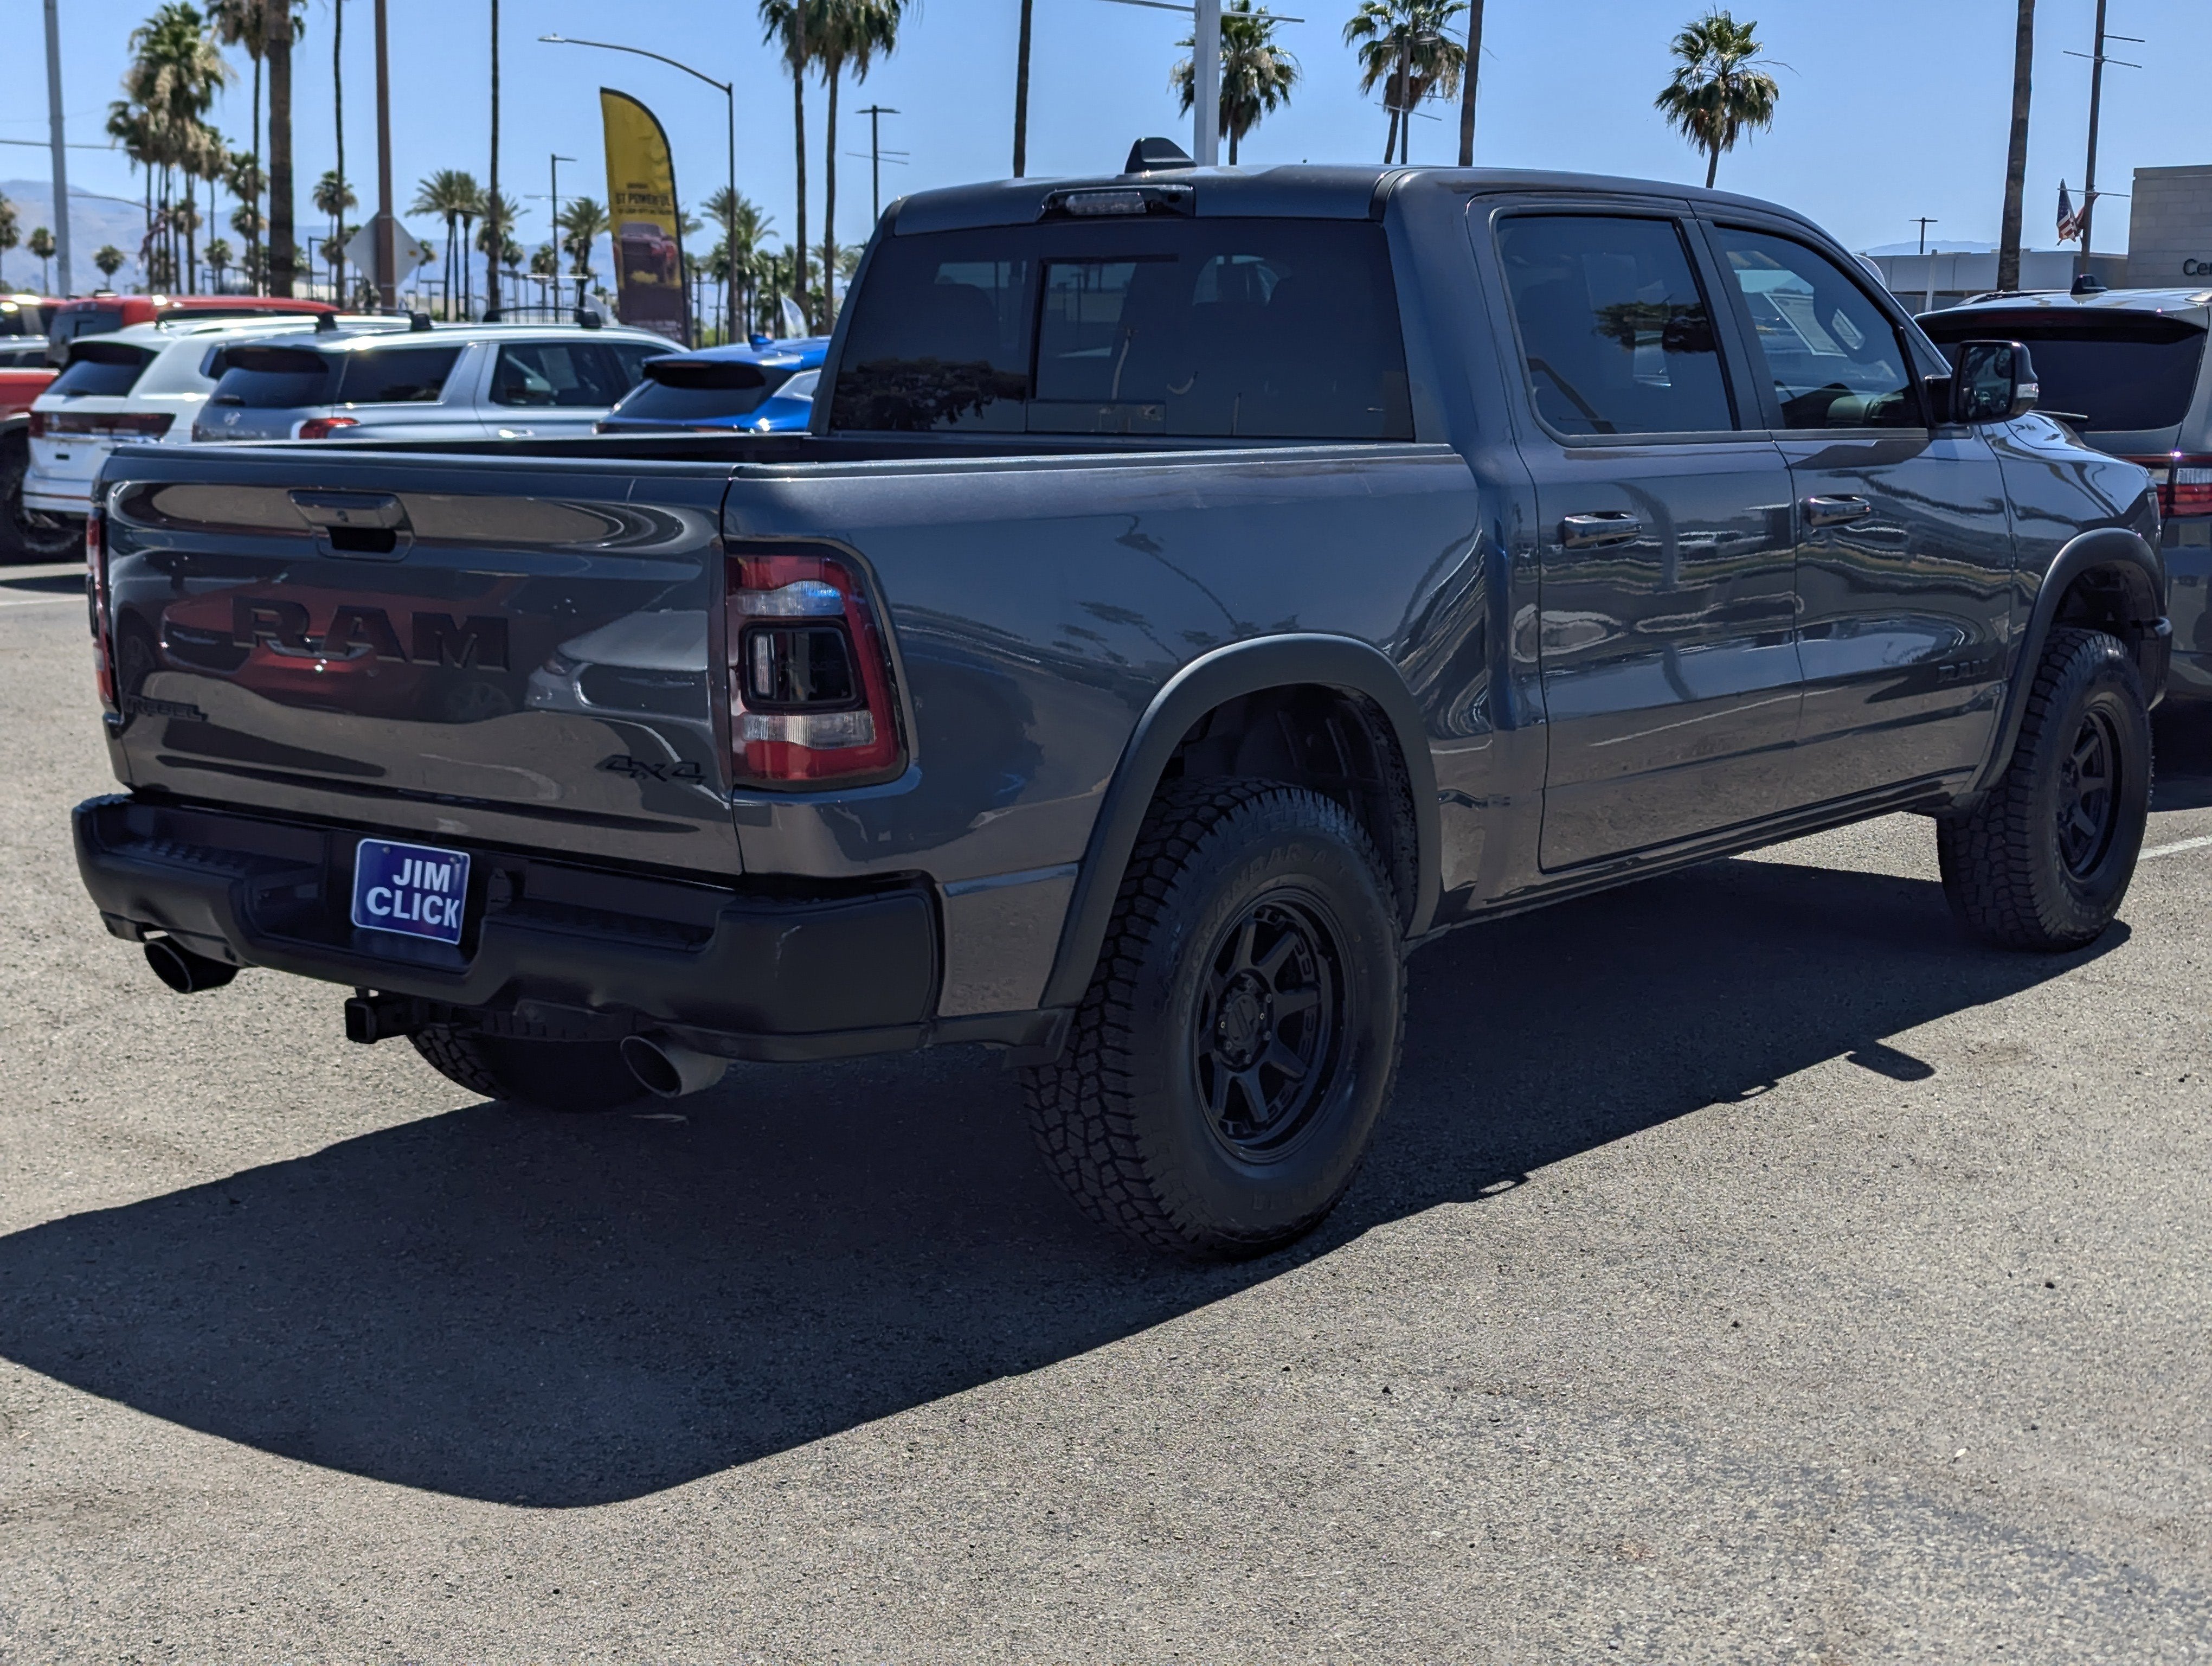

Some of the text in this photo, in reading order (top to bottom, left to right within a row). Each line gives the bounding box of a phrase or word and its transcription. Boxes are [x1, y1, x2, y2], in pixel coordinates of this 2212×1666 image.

[232, 595, 511, 673] RAM
[391, 858, 451, 893] JIM
[366, 886, 461, 929] CLICK
